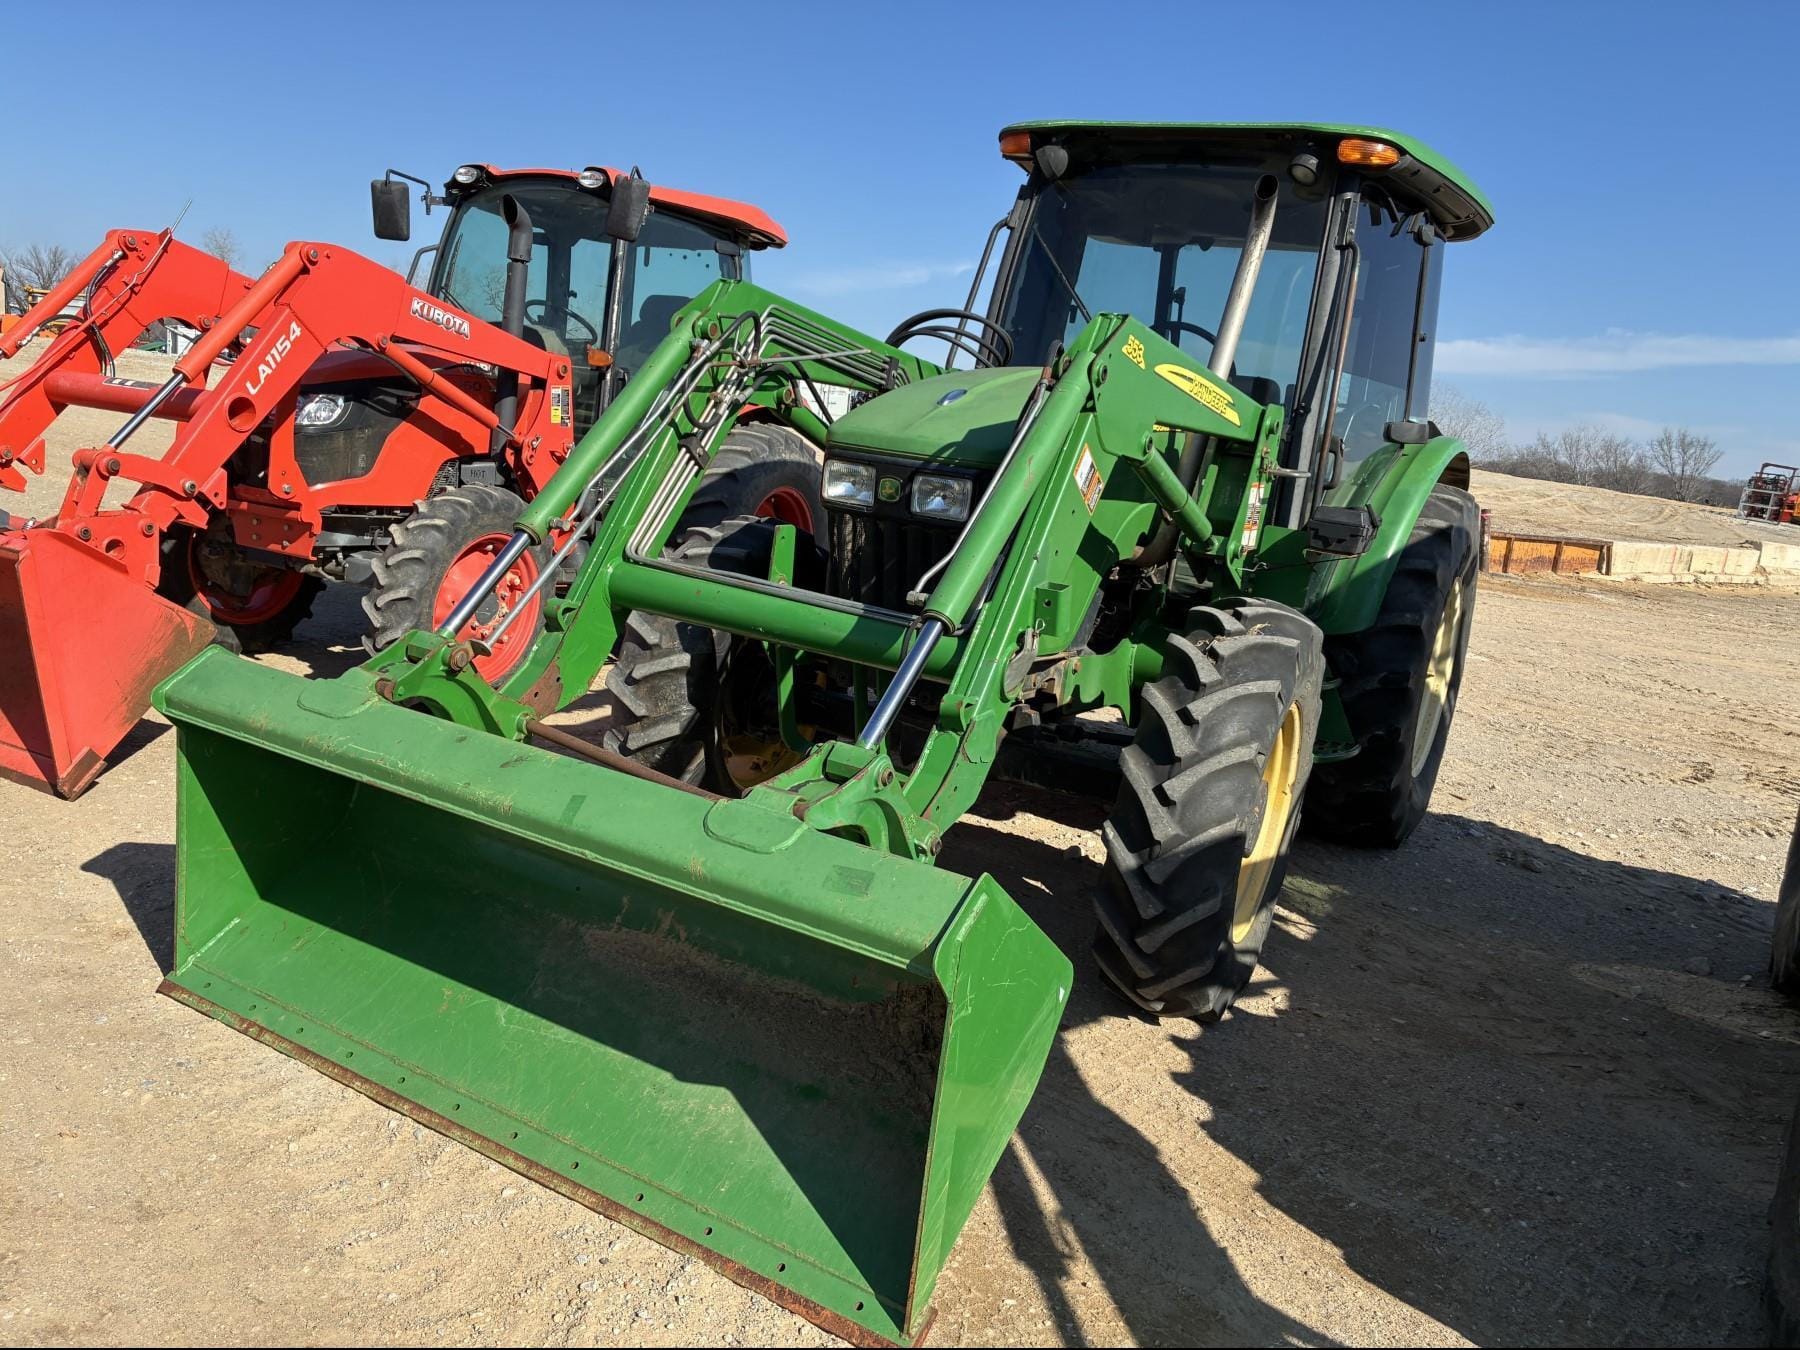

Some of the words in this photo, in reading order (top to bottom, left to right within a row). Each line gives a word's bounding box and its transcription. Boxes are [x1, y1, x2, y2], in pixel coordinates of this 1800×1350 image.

[411, 297, 470, 340] KUBOTA
[245, 320, 302, 395] LA1154
[1124, 336, 1144, 366] 553
